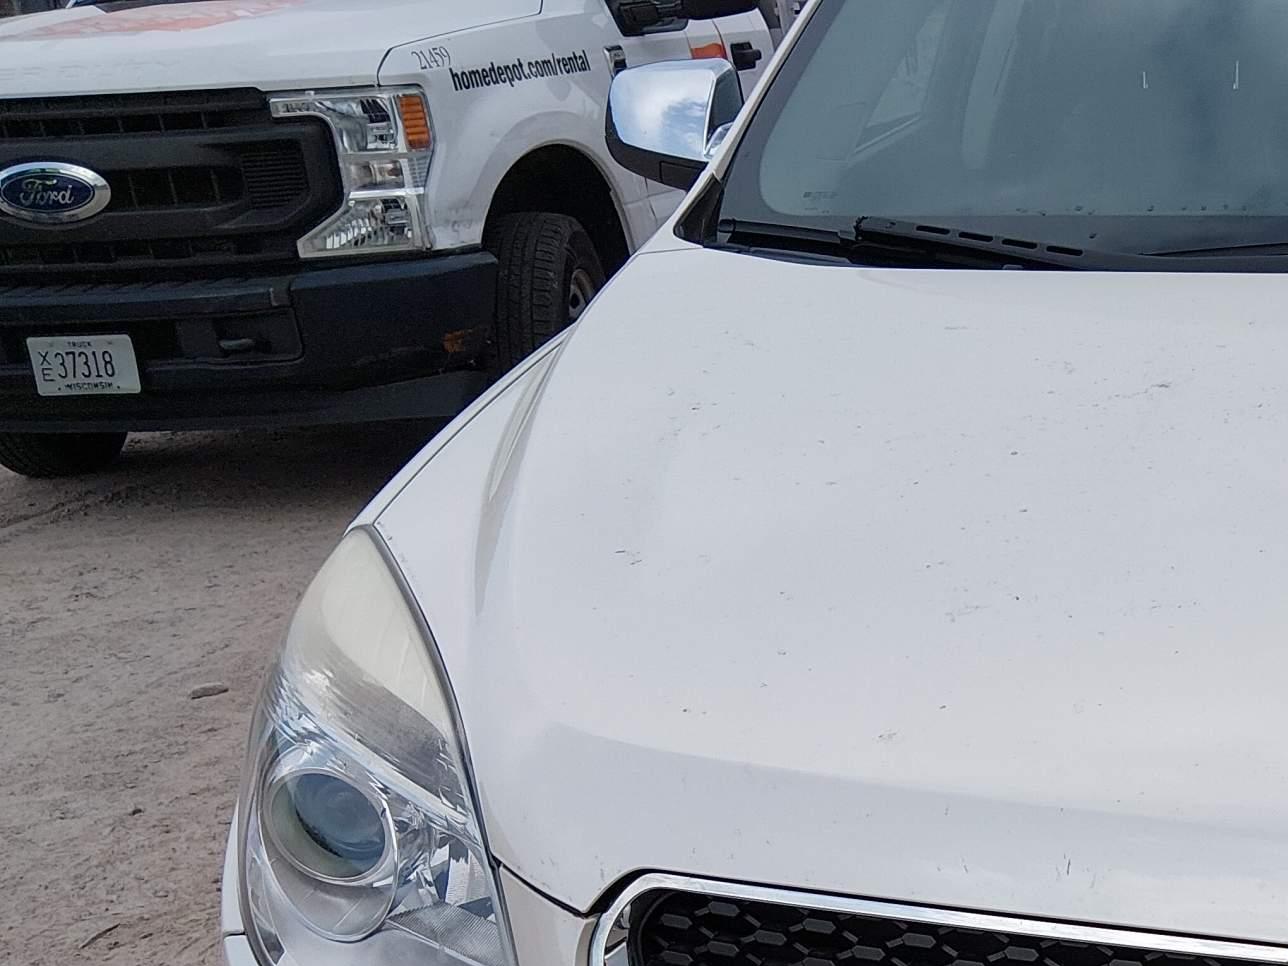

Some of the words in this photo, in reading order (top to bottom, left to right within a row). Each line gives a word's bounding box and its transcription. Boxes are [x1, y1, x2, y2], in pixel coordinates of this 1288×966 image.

[411, 46, 451, 70] 21459
[449, 49, 592, 92] homedepot.com/rental
[19, 178, 75, 206] Ford
[54, 350, 116, 379] 37318
